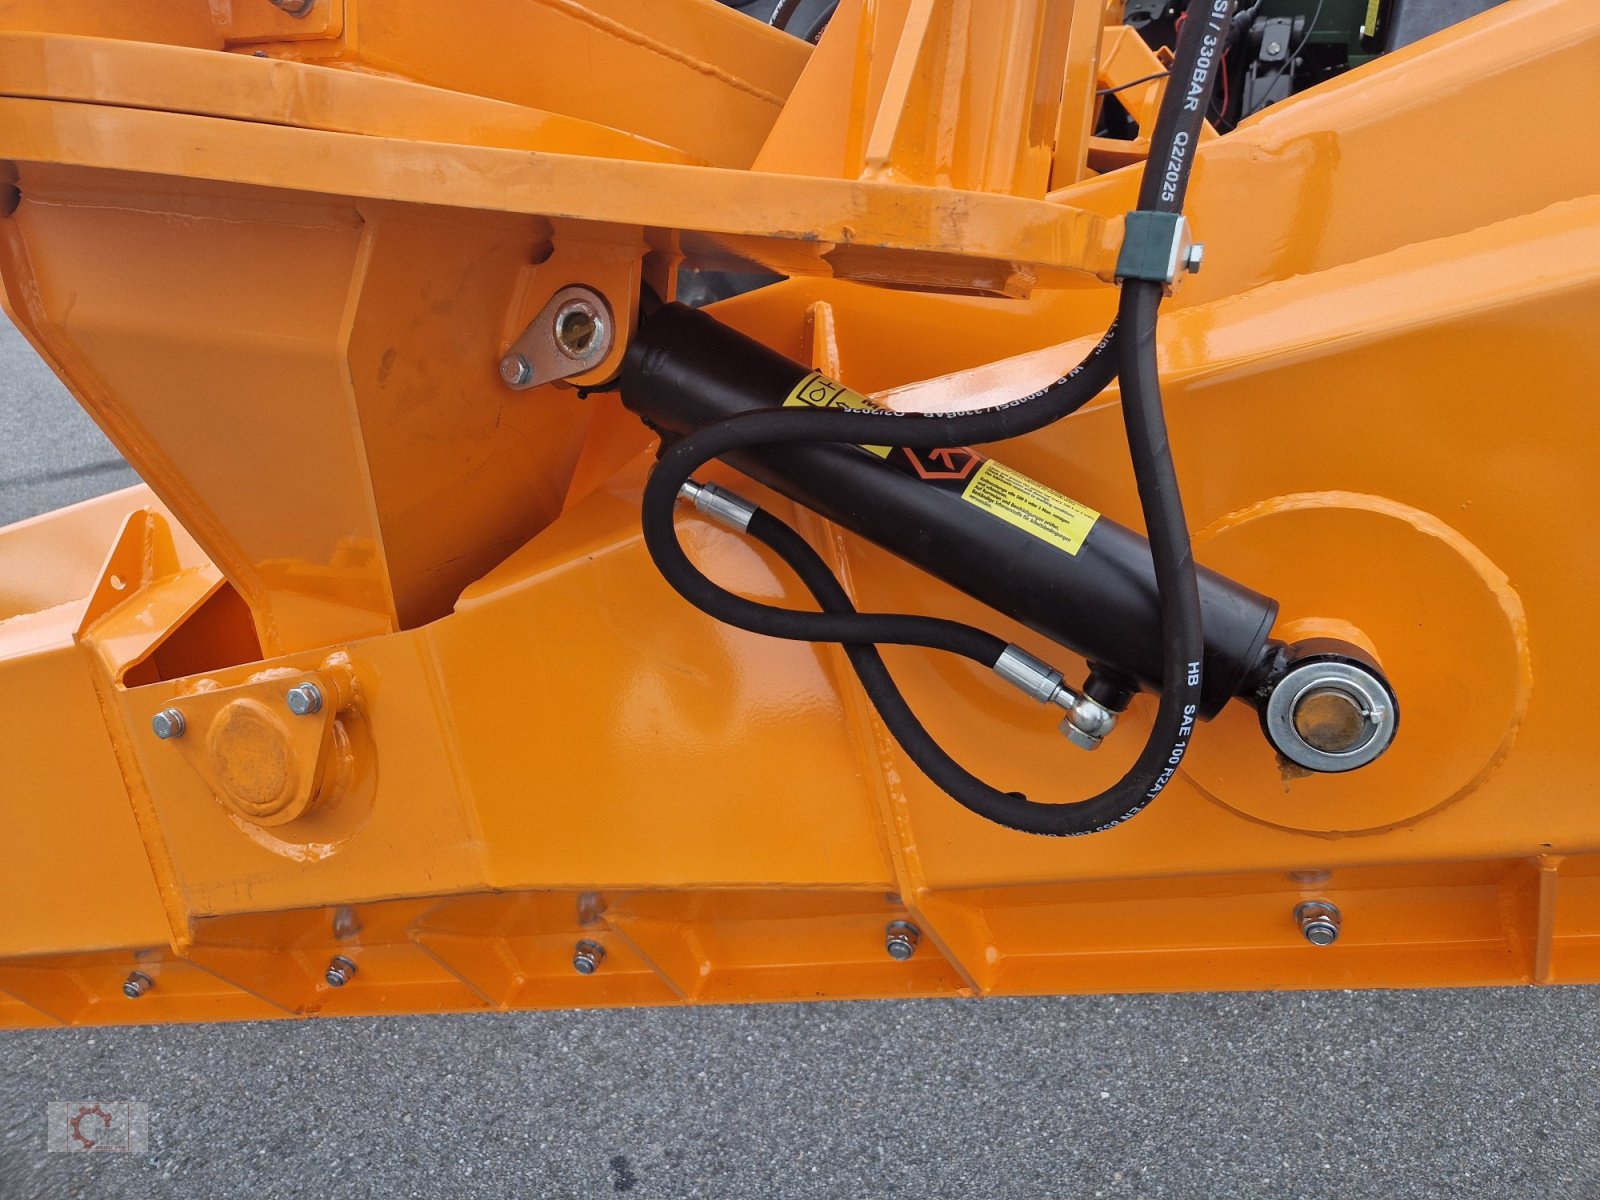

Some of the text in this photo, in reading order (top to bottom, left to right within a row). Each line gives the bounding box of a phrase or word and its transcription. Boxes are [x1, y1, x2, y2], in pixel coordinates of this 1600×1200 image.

[1184, 36, 1217, 111] 330BAR
[1162, 131, 1189, 202] Q2/2025
[1187, 661, 1200, 687] HB
[1178, 704, 1196, 736] SAE
[1168, 741, 1186, 764] 100
[1146, 767, 1175, 799] R2AT
[1120, 806, 1142, 821] EN
